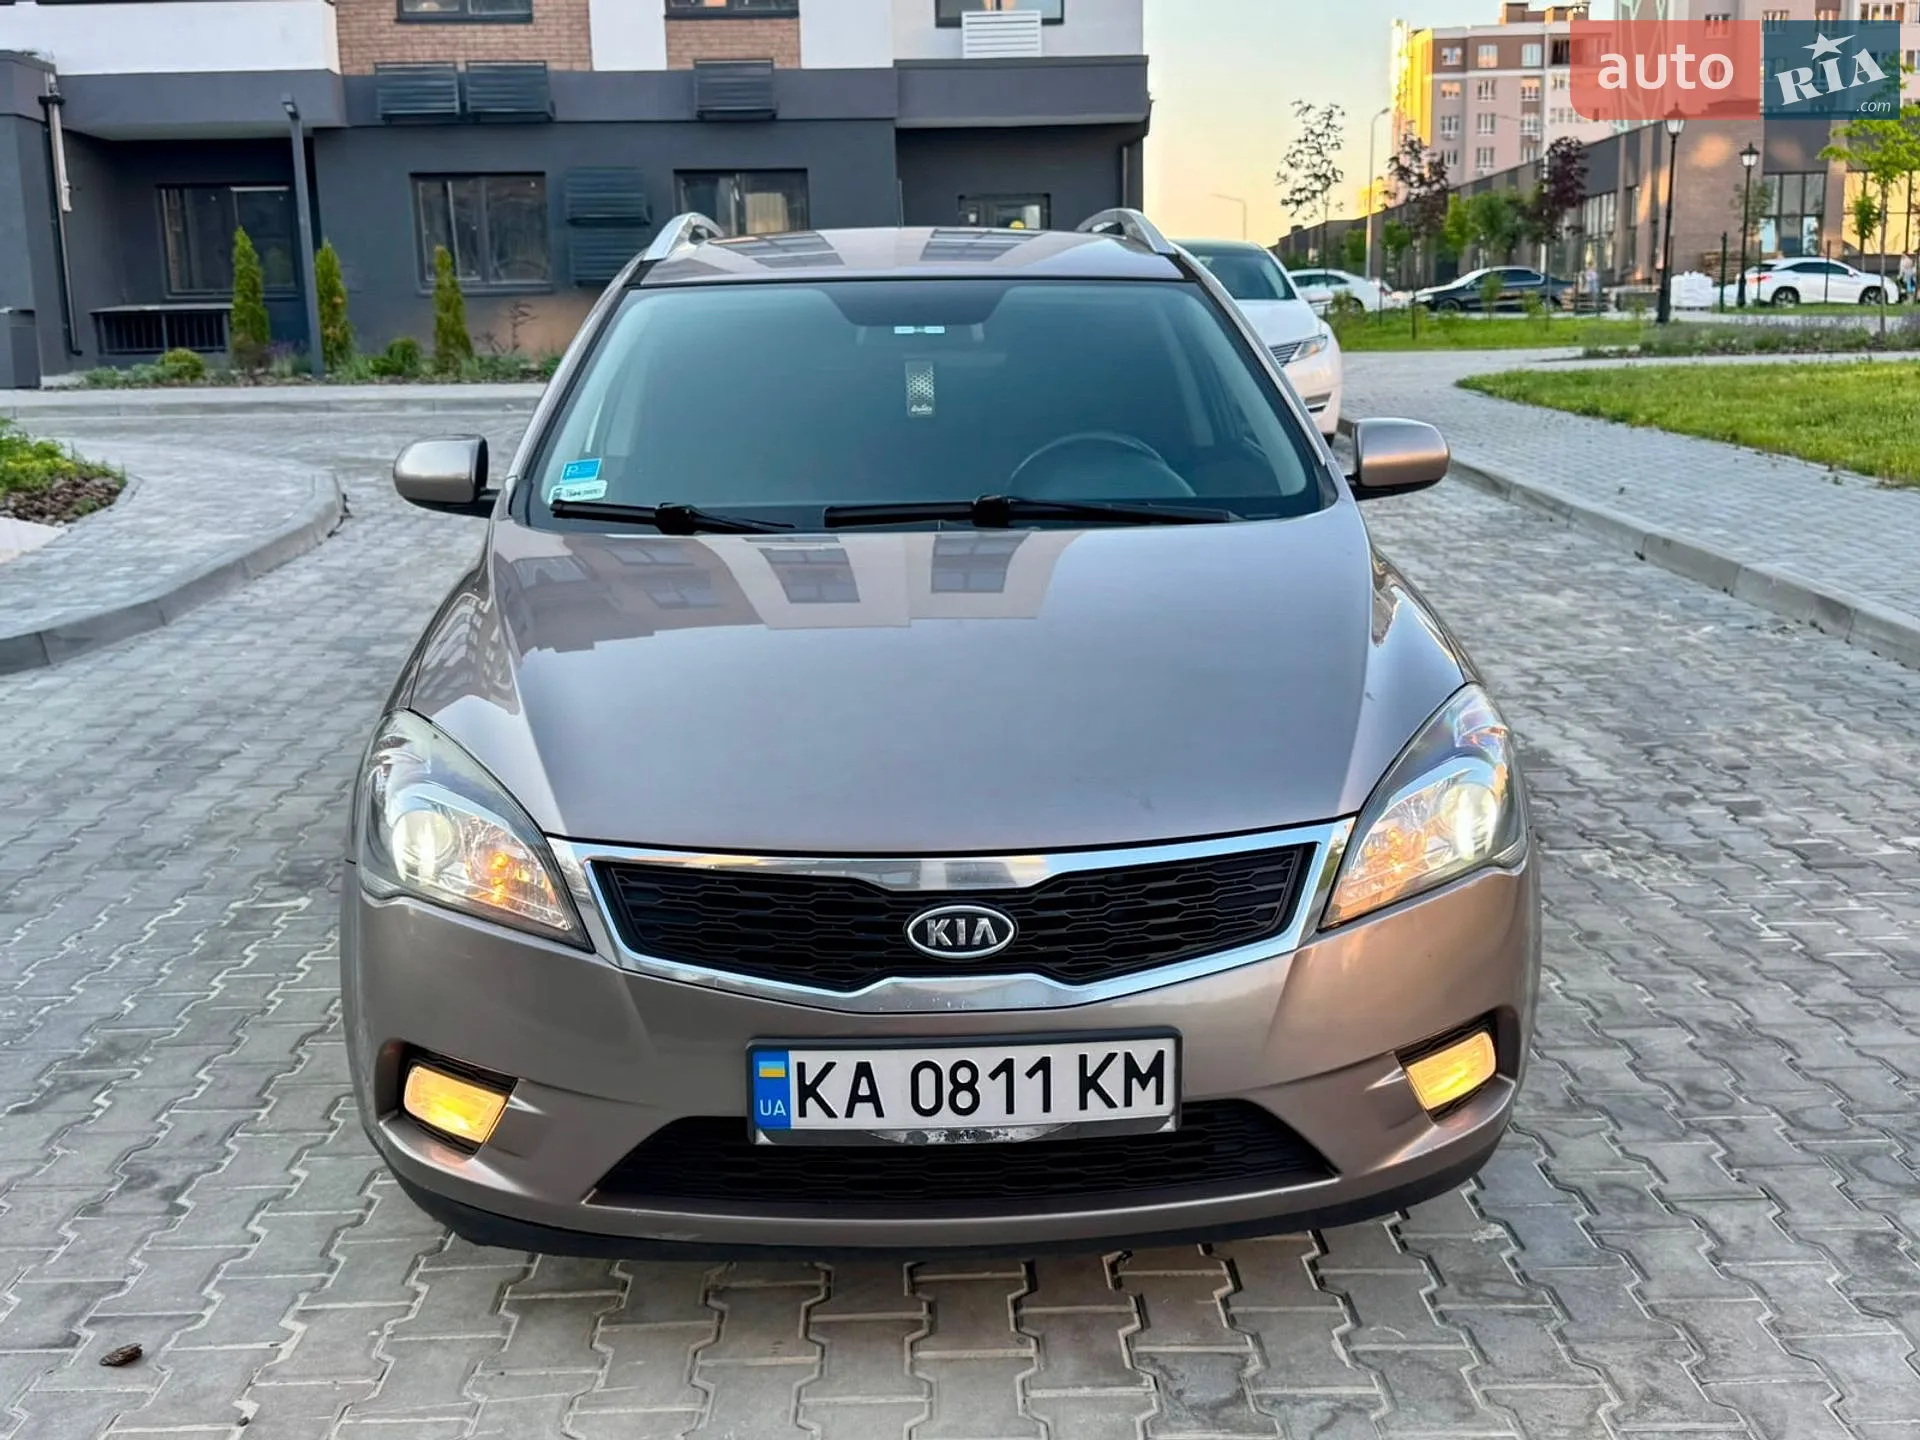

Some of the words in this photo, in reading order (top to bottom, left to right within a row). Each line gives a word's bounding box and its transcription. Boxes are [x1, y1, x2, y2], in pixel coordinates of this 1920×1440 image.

[926, 917, 998, 947] KIA
[796, 1061, 885, 1119] KA
[910, 1056, 1052, 1118] 0811
[1078, 1049, 1165, 1111] KM
[759, 1099, 787, 1116] UA
